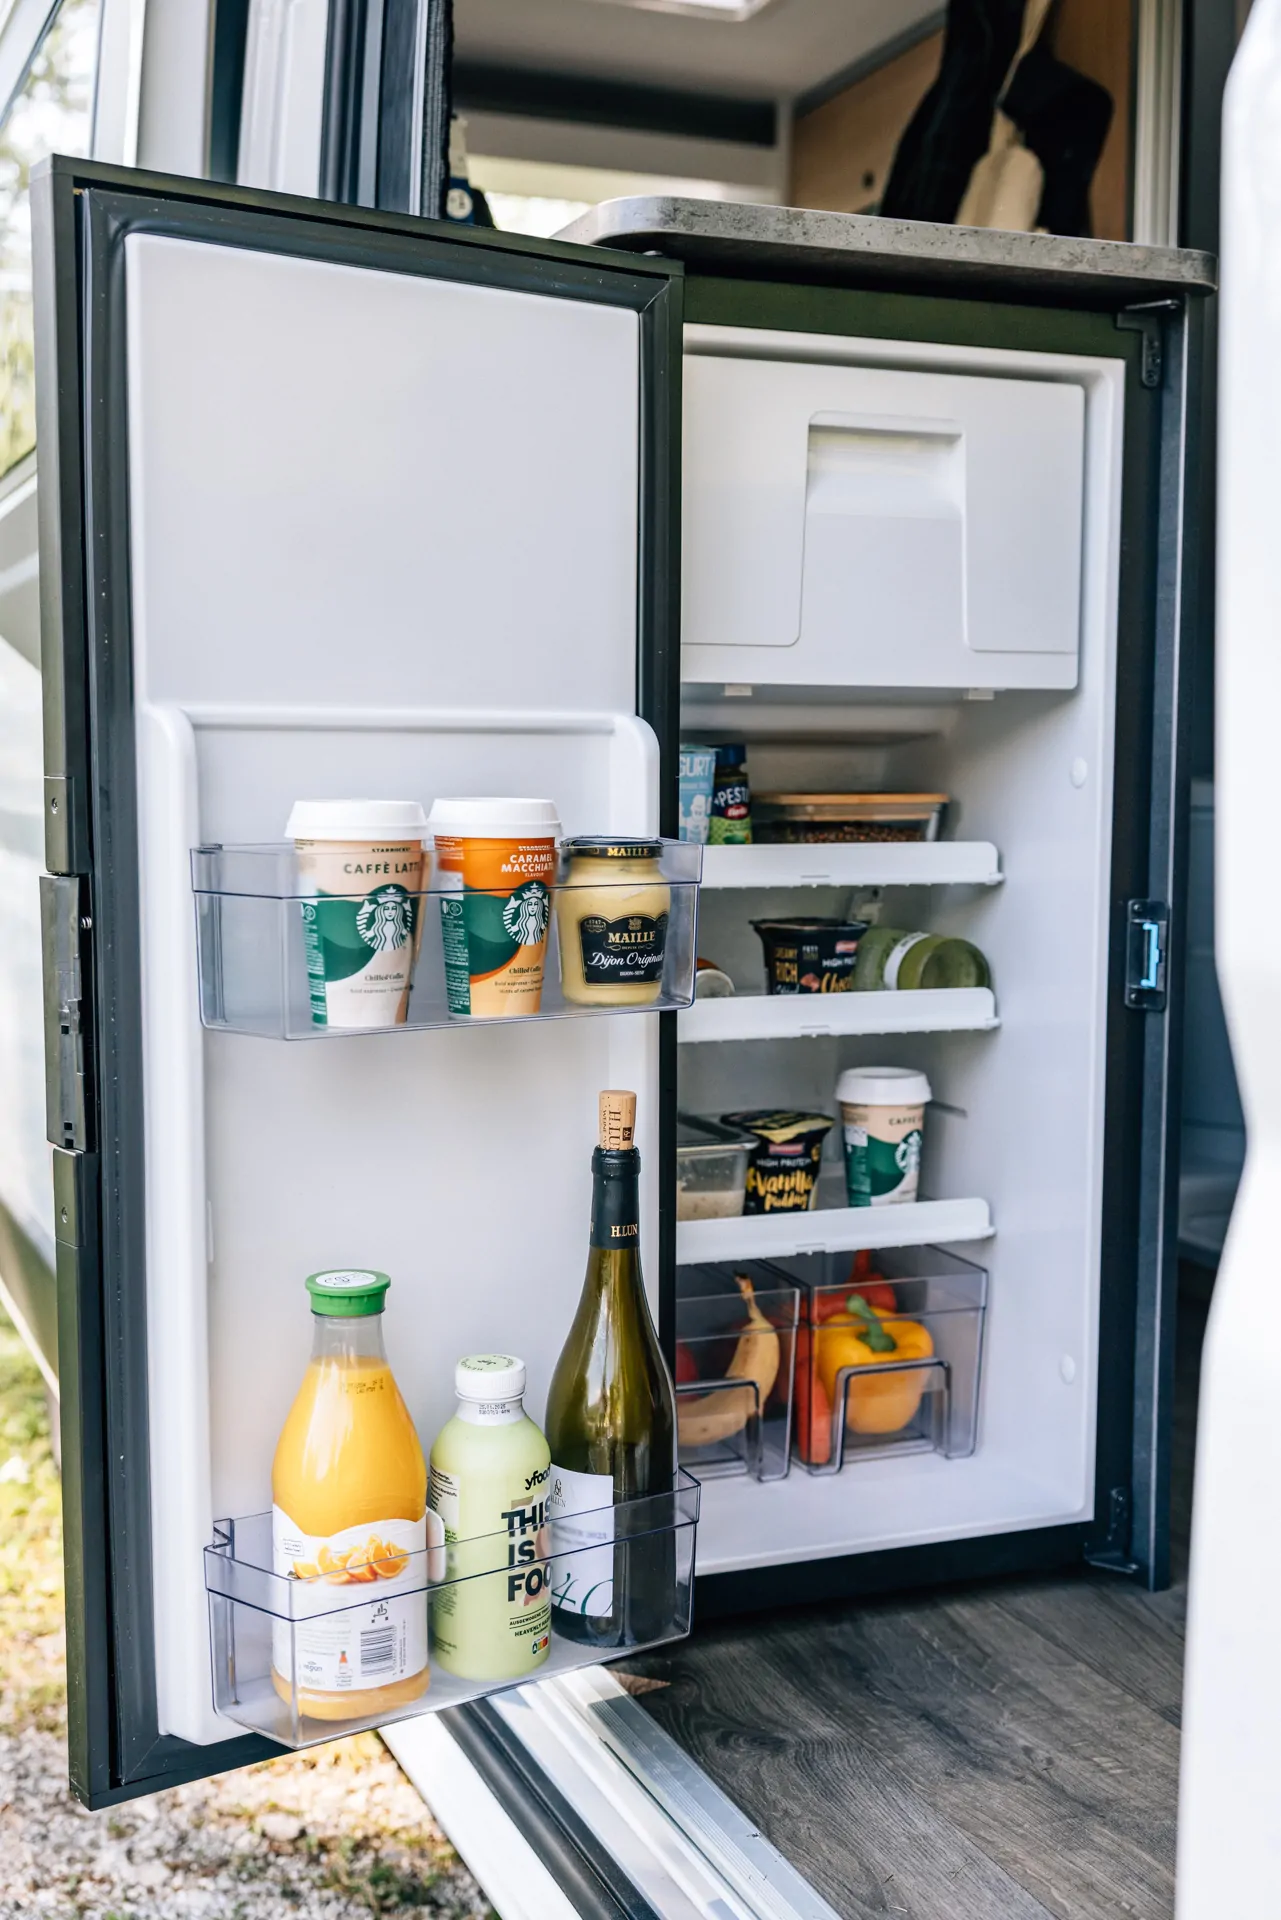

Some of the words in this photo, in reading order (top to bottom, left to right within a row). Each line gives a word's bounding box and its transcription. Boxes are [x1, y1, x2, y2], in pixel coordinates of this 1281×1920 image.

[510, 853, 553, 864] CARAMEL
[607, 847, 651, 857] MAILLE
[343, 861, 390, 875] CAFFÈ
[394, 861, 420, 873] LATT
[608, 931, 656, 943] MAILLE
[588, 952, 625, 969] Dijon
[626, 950, 664, 969] Original
[509, 1540, 535, 1566] IS
[508, 1561, 551, 1602] FOO
